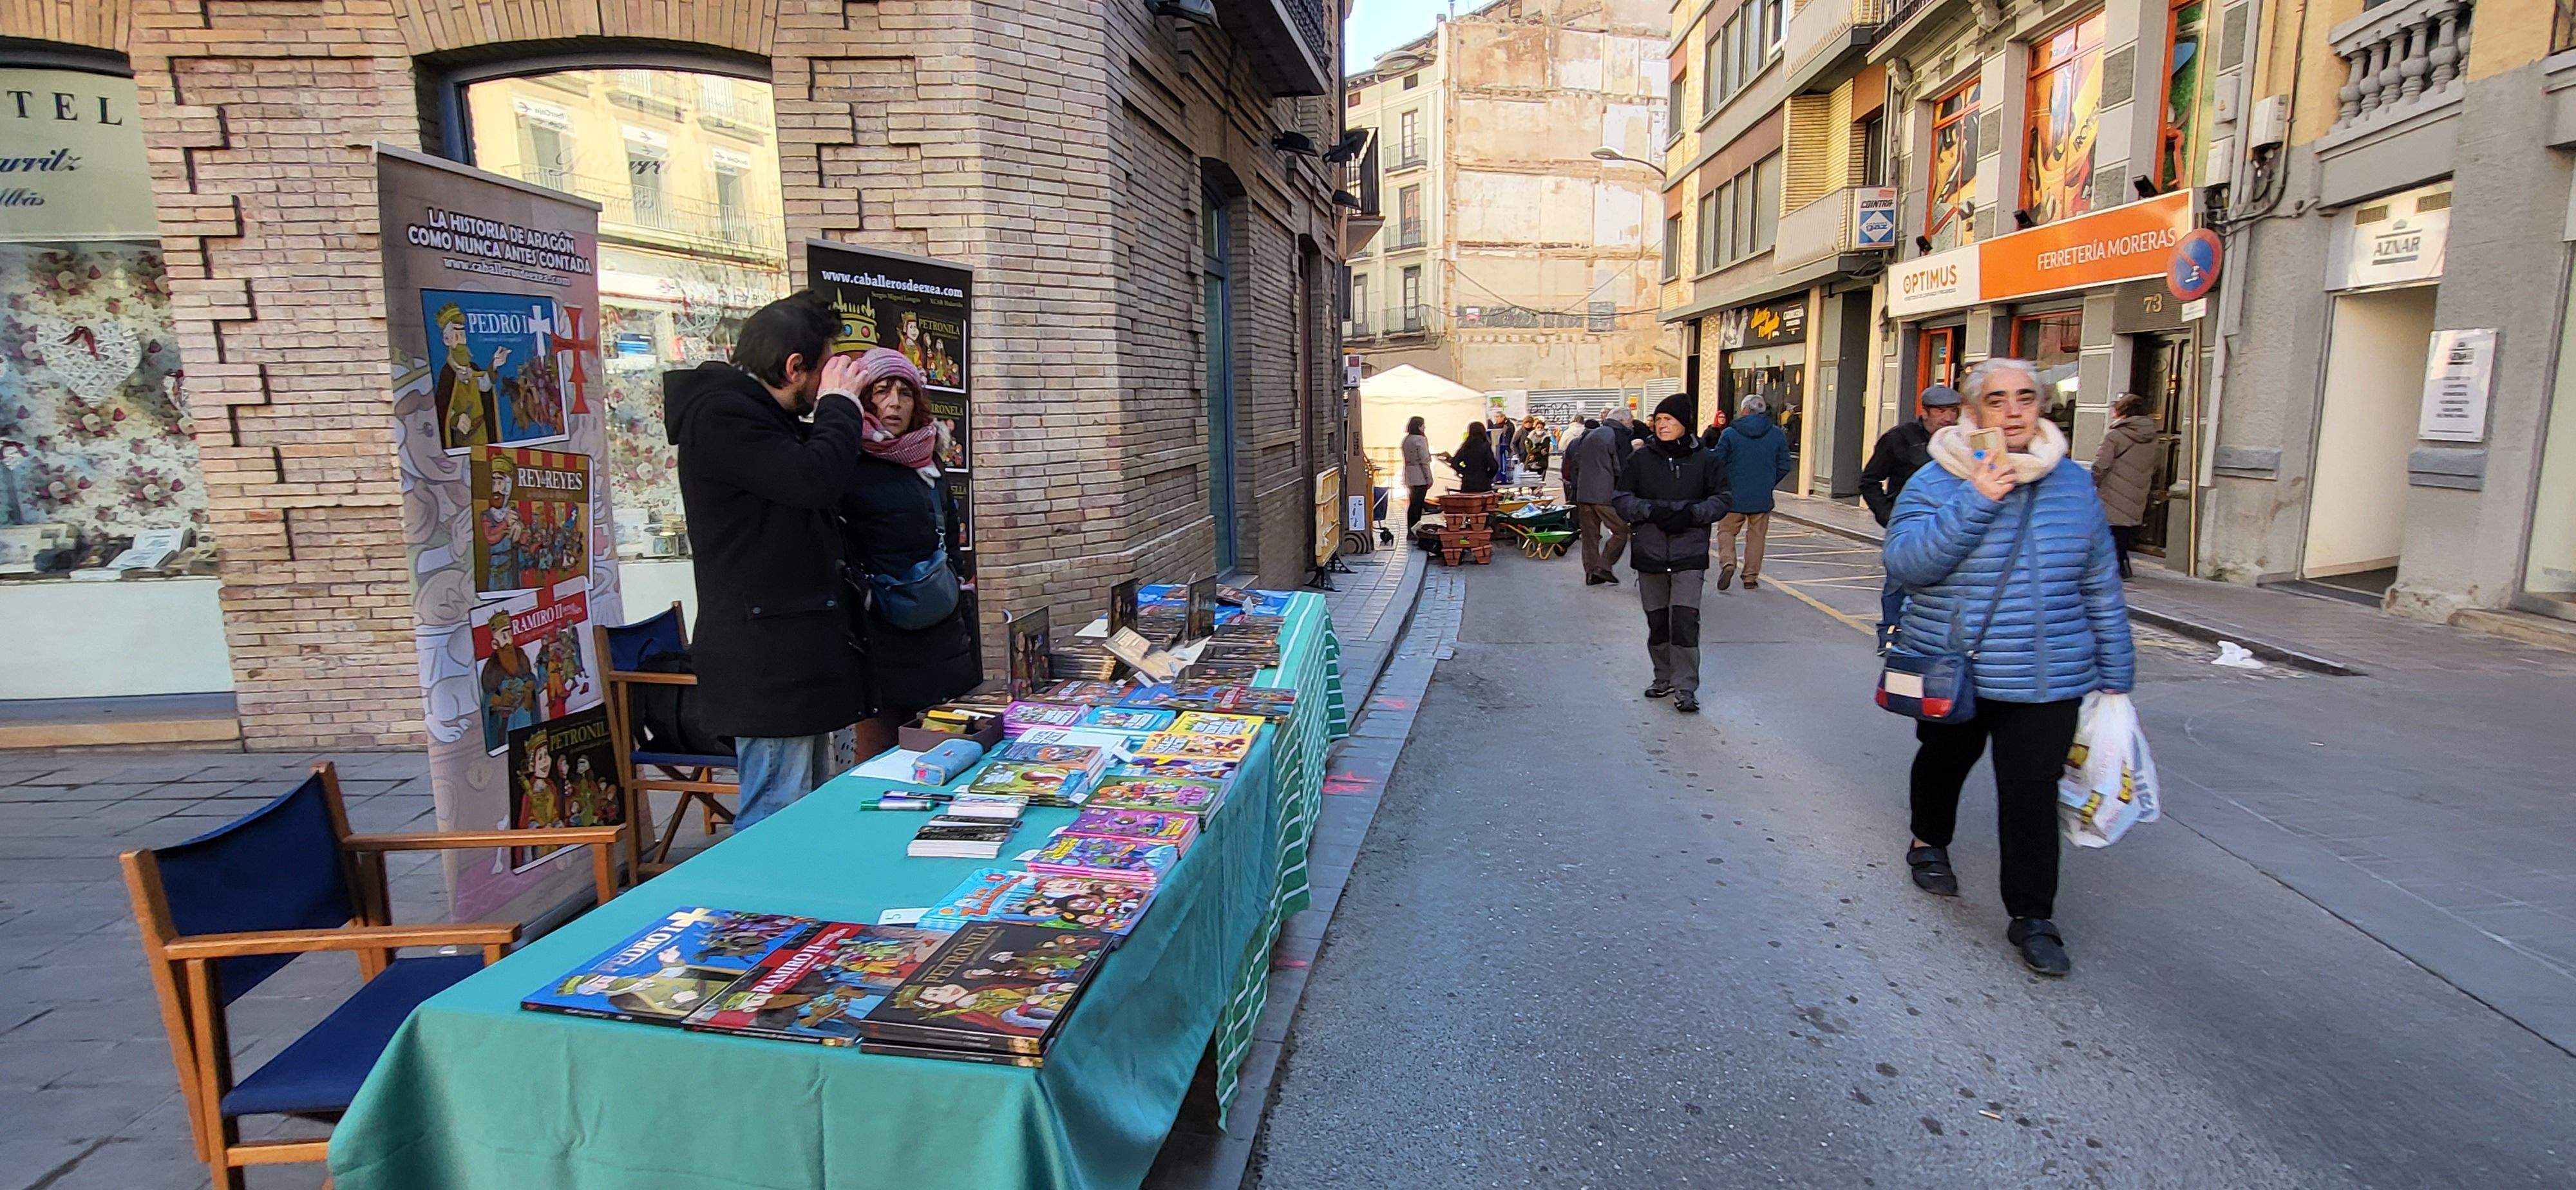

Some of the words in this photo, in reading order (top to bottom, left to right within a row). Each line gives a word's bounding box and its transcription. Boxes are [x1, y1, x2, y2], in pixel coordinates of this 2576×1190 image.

[1860, 200, 1894, 209] COINTRA
[428, 209, 448, 229] LA
[450, 212, 508, 241] HISTORIA
[509, 226, 525, 244] DE
[527, 230, 576, 254] ARAGÓN
[2374, 236, 2421, 257] AZNAR
[408, 225, 451, 250] COMO
[455, 234, 502, 259] NUNCA
[505, 243, 538, 265] ANTES
[538, 251, 592, 275] CONTADA
[2037, 238, 2106, 271] FERRETERÍA
[2107, 227, 2177, 258] MORERAS
[821, 269, 964, 298] www.caballerosdeexea.com
[1903, 264, 1957, 294] OPTIMUS
[2143, 293, 2163, 314] 73
[467, 313, 521, 334] PEDRO
[522, 315, 529, 334] I
[918, 318, 960, 335] PETRONILA
[517, 468, 542, 487] REY
[545, 470, 583, 490] REYES
[512, 607, 554, 636] RAMIRO
[554, 603, 564, 619] II
[596, 933, 672, 973] PEDRO
[921, 925, 999, 984] PETRONILA
[750, 952, 814, 993] RAMIRO
[800, 945, 825, 954] II
